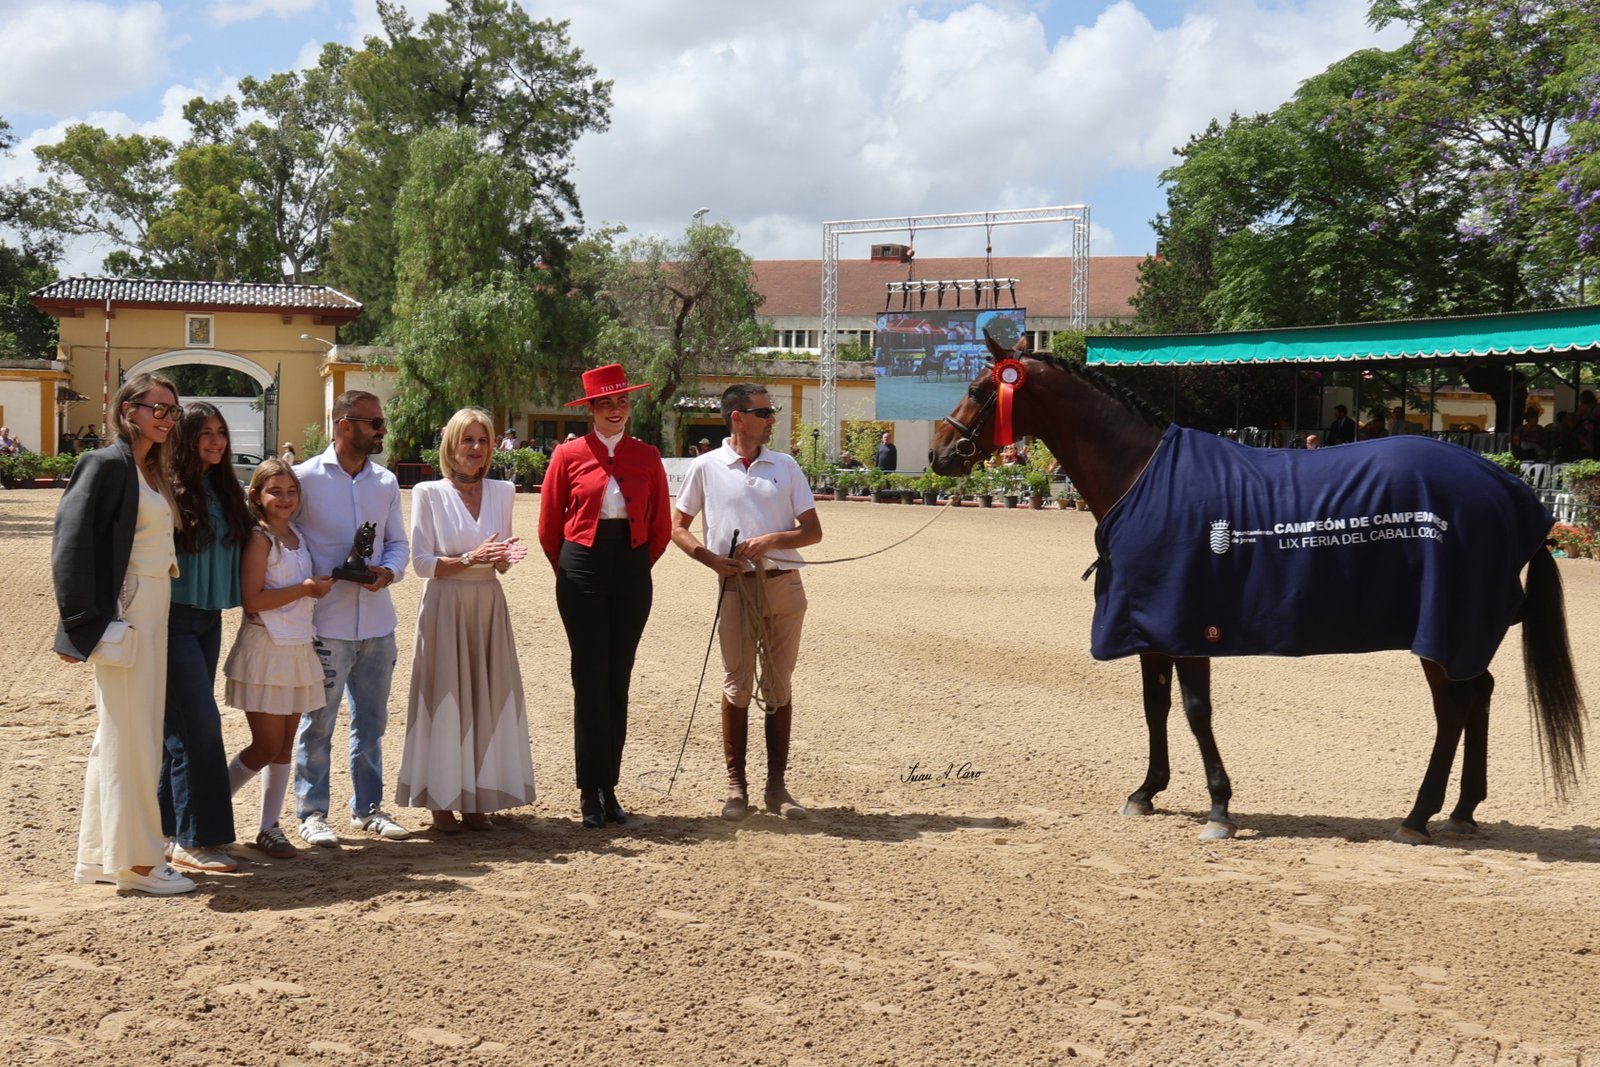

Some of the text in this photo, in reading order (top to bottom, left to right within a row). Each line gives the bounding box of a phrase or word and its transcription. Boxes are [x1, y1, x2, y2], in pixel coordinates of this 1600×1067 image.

[1274, 518, 1346, 534] CAMPEÓN
[1349, 516, 1370, 528] DE
[1279, 538, 1299, 549] LIX
[1302, 535, 1340, 548] FERIA
[1342, 532, 1367, 545] DEL
[1370, 526, 1425, 541] CABALLO
